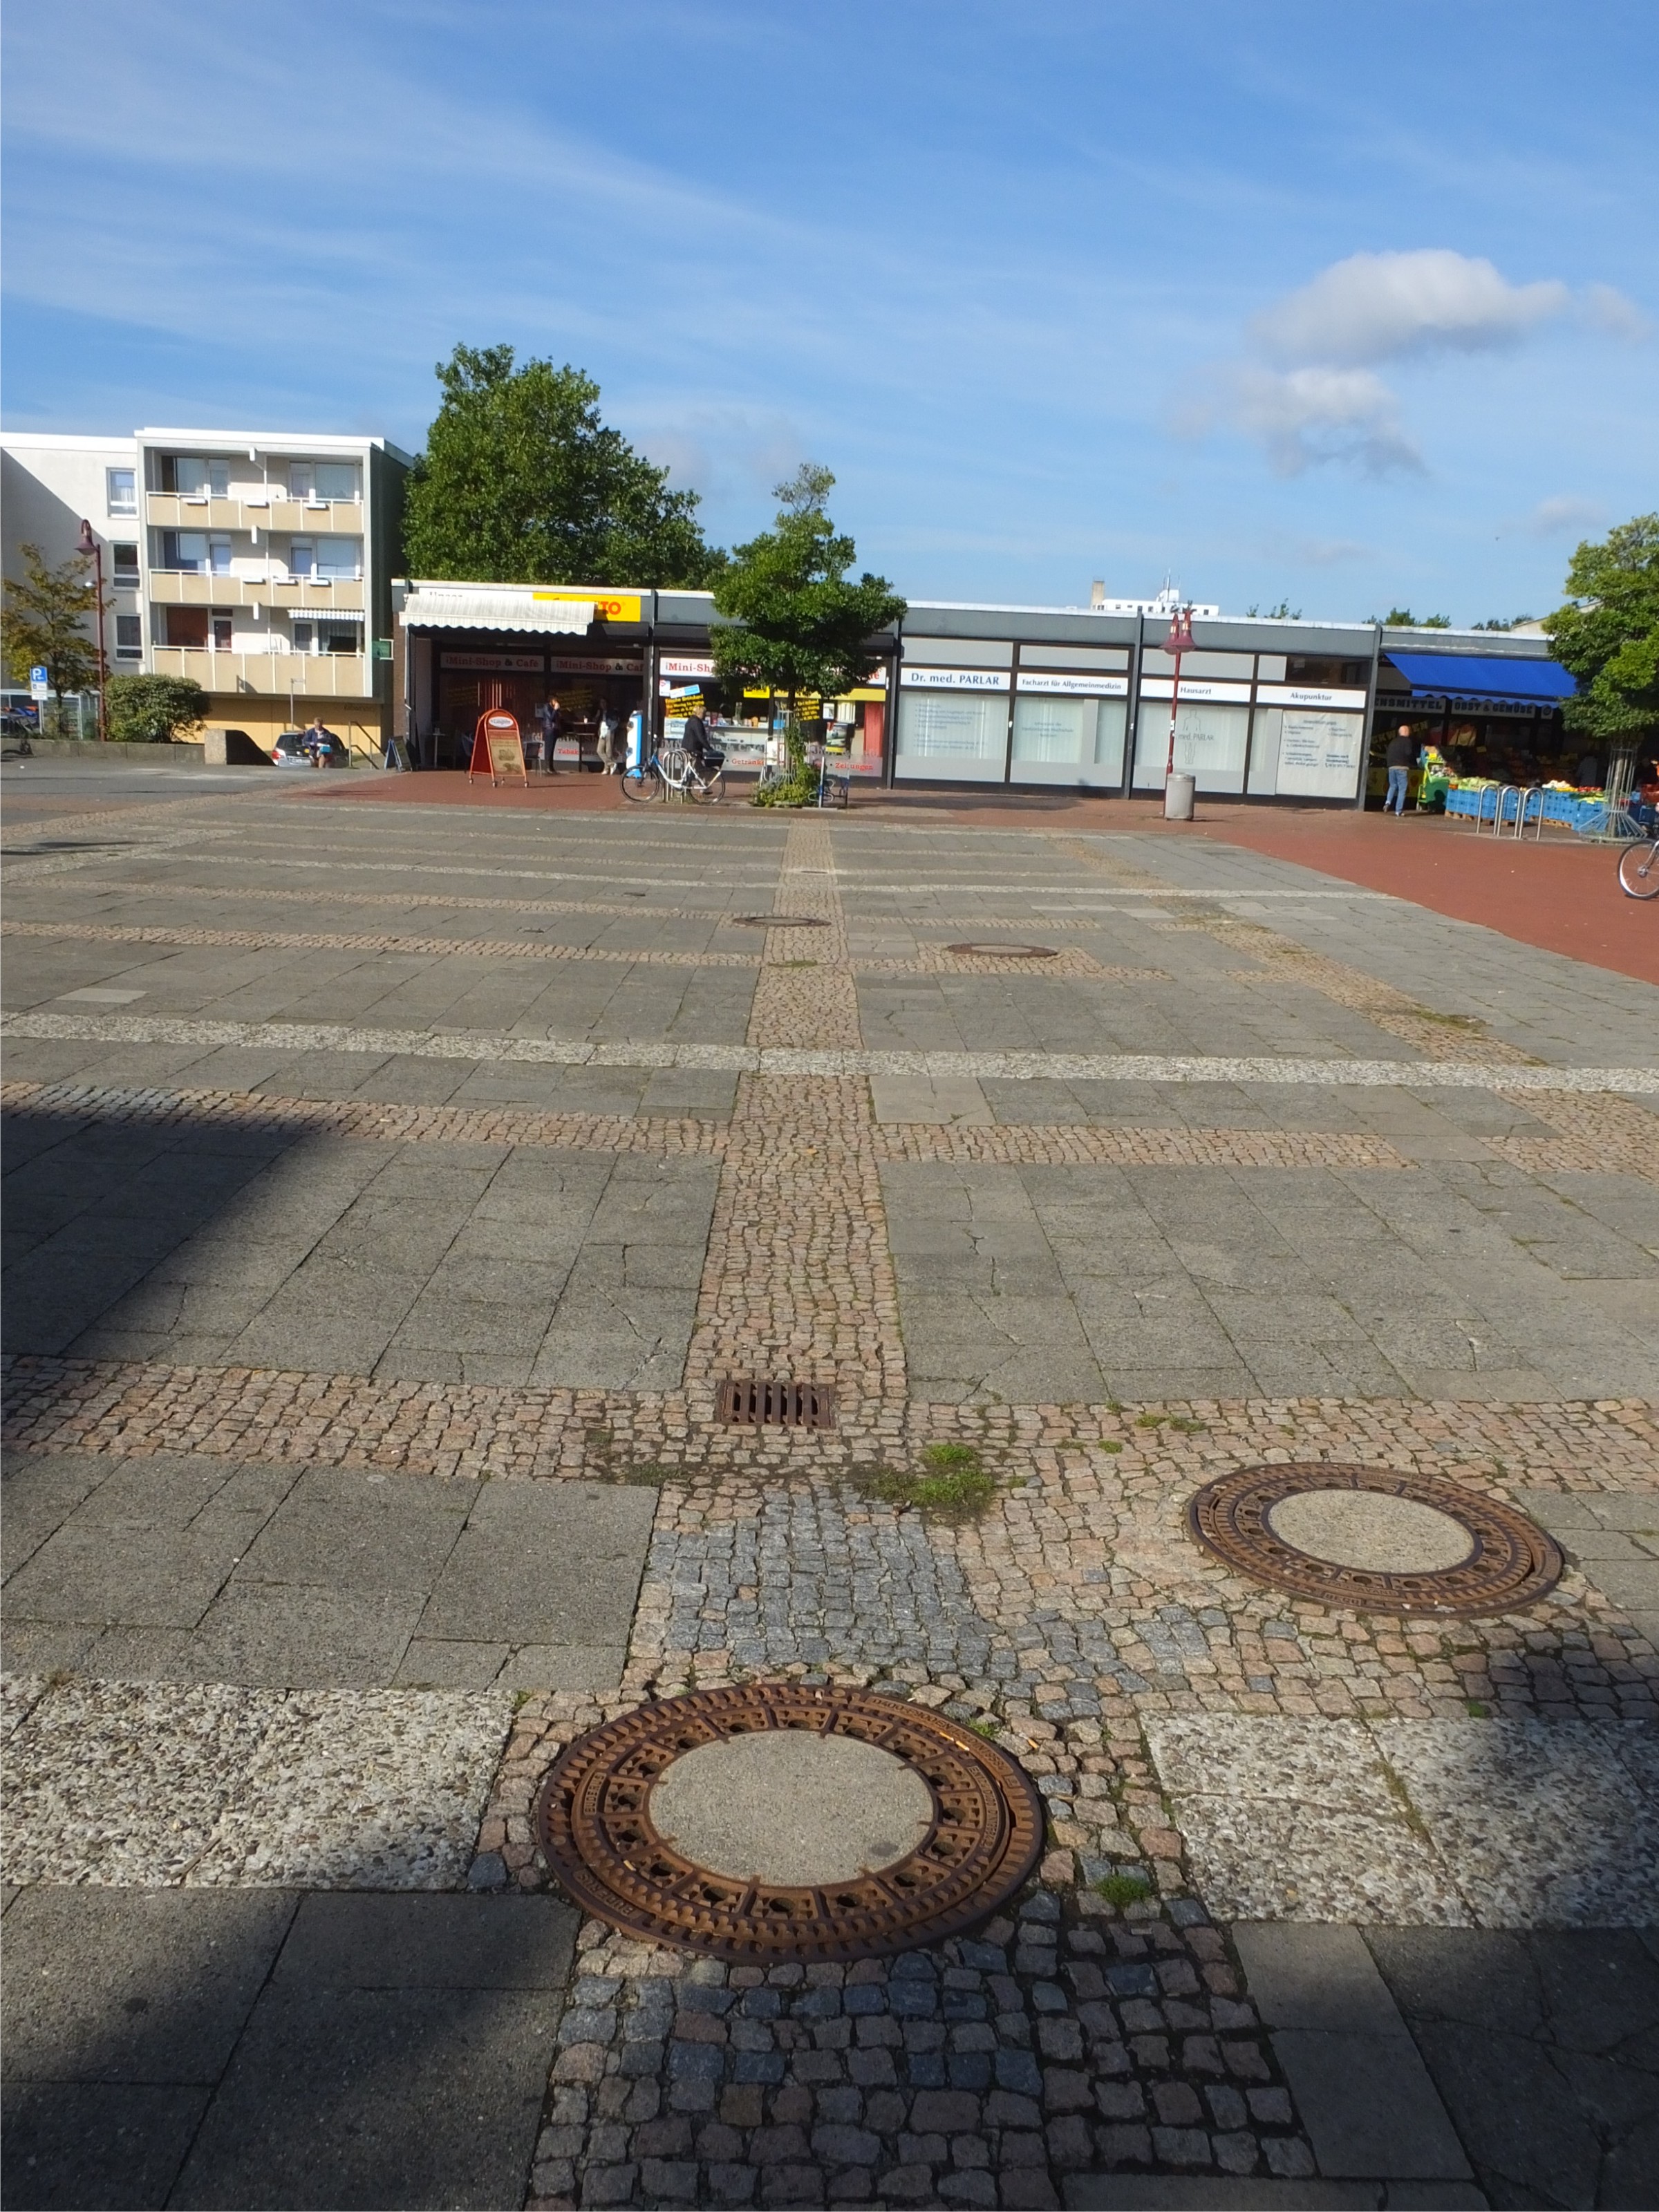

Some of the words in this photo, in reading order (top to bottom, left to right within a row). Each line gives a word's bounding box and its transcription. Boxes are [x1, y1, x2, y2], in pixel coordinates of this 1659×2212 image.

[505, 657, 513, 666] &
[516, 659, 538, 668] Café
[615, 662, 624, 671] &
[626, 663, 644, 672] Caf
[910, 673, 926, 682] Dr.
[930, 674, 955, 684] med.
[959, 675, 1000, 685] PARLAR
[1022, 678, 1050, 686] Facharzt
[1062, 680, 1122, 690] Allgemeinmedizin
[1180, 686, 1212, 695] Hausarzt
[1290, 691, 1333, 702] Akupunktur
[1454, 702, 1481, 711] OBST
[1492, 702, 1533, 714] GEMÜSE
[1193, 733, 1215, 741] PARLAR
[835, 762, 873, 771] Zeiungen
